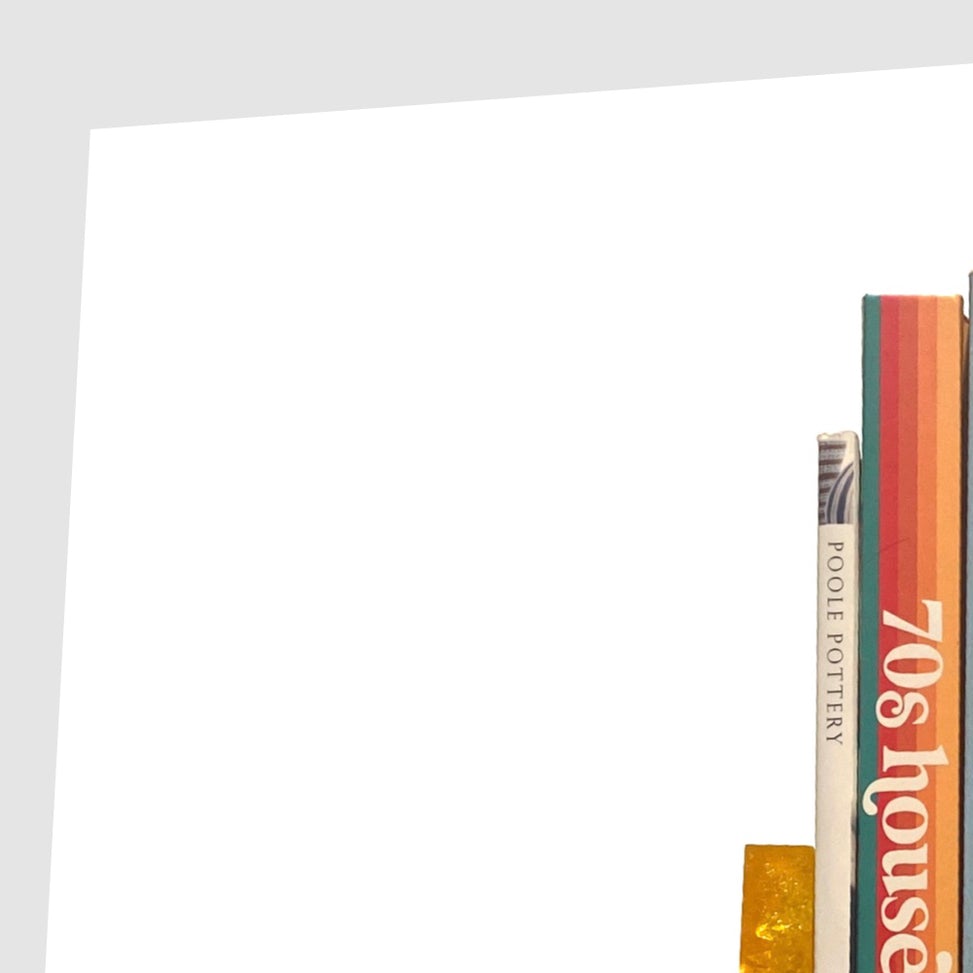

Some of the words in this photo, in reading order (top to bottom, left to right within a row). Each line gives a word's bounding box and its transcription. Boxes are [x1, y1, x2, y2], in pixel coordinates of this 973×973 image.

[826, 541, 844, 621] POOLE
[826, 633, 844, 746] POTTERY
[876, 600, 944, 729] 70s
